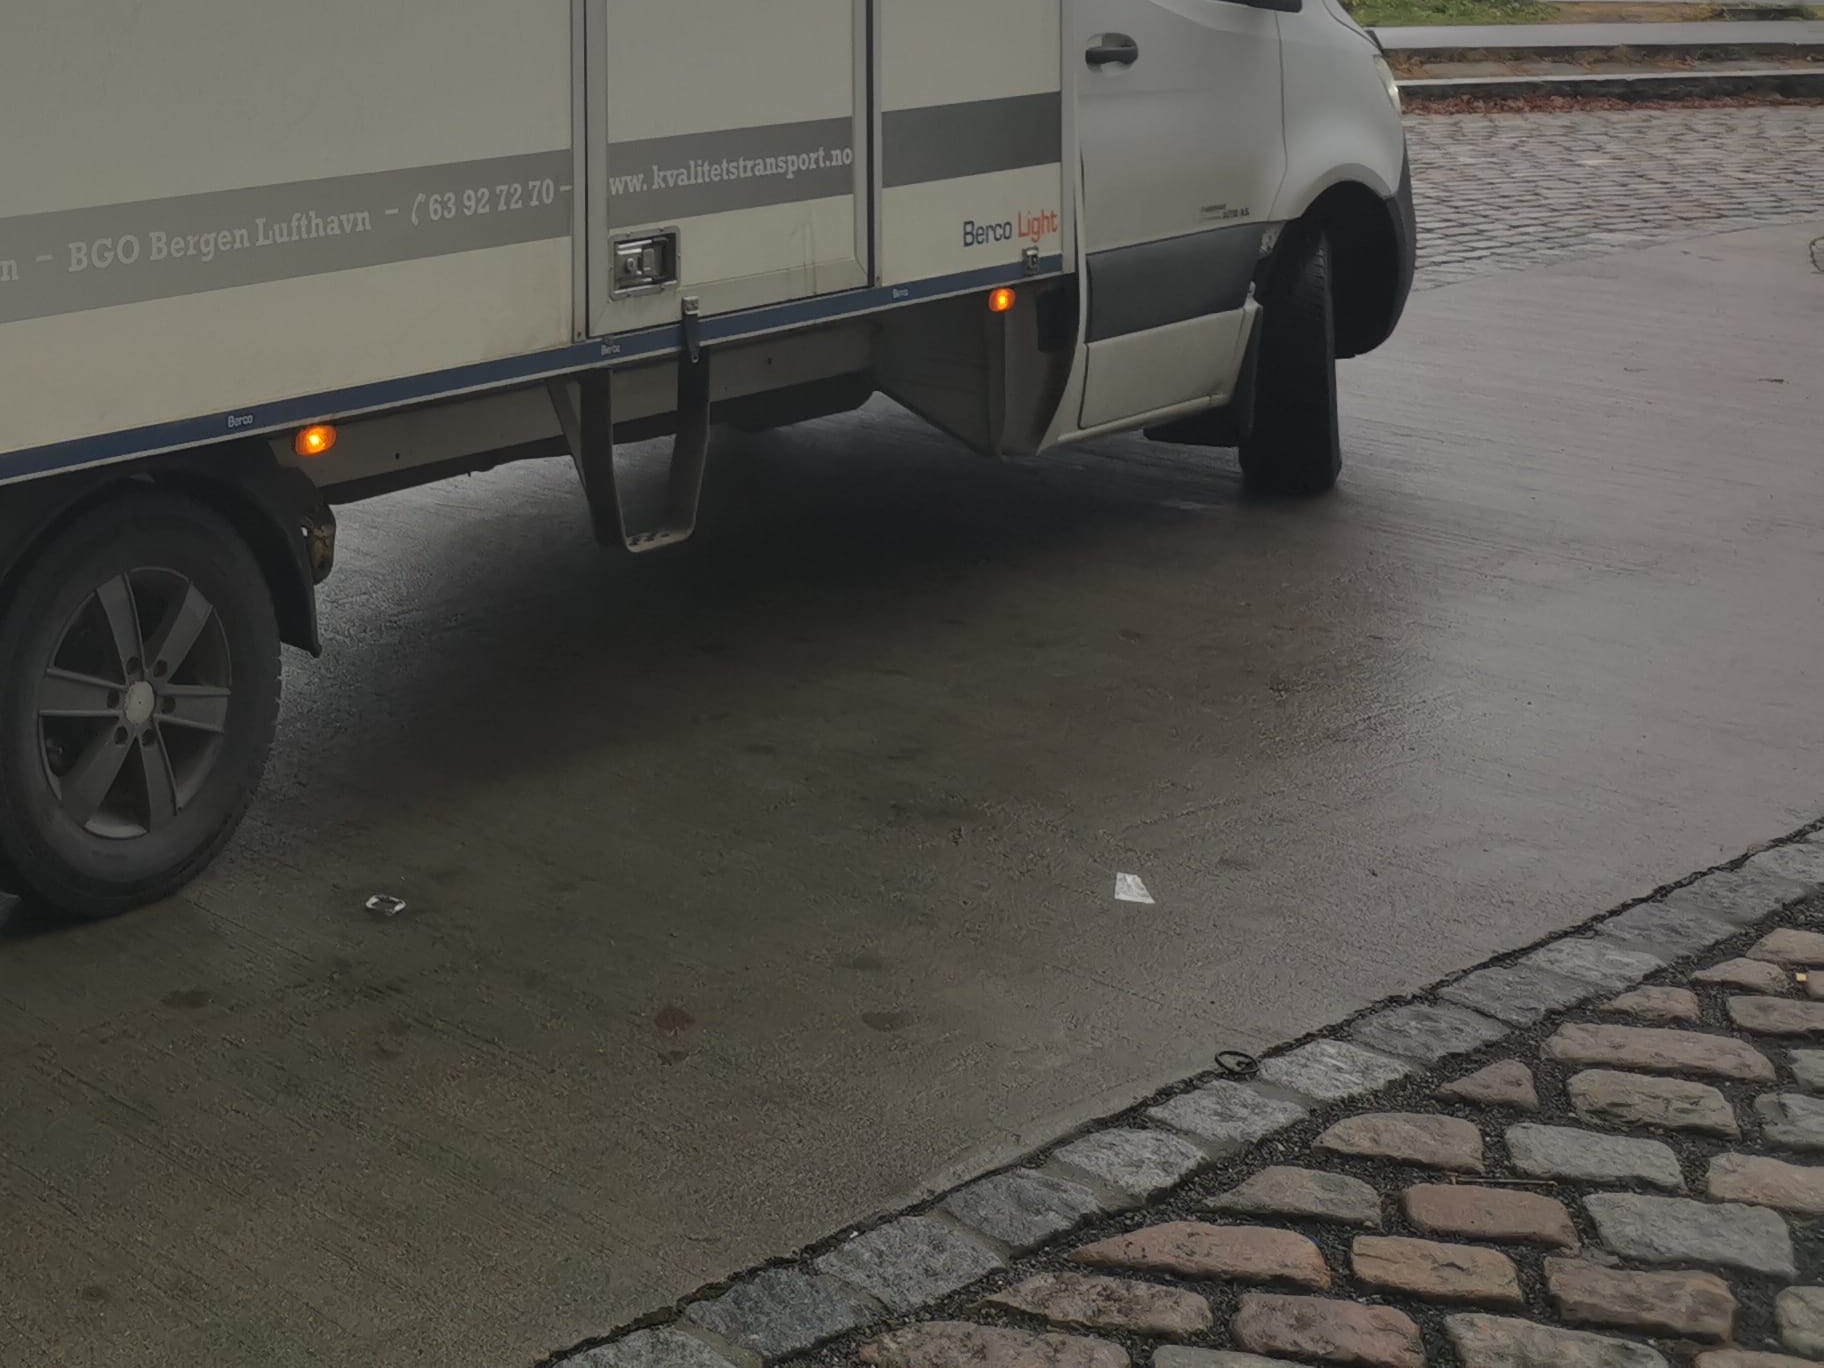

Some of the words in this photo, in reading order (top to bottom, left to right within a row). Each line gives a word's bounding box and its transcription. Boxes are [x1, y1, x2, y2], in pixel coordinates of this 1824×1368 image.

[67, 235, 141, 272] BGO
[149, 228, 250, 262] Bergen
[255, 209, 373, 247] Lufthavn
[429, 191, 457, 221] 63
[463, 186, 490, 216] 92
[496, 182, 522, 211] 72
[528, 178, 554, 207] 70
[963, 220, 1012, 247] Berco
[1018, 208, 1058, 243] Light
[227, 414, 254, 428] Berco
